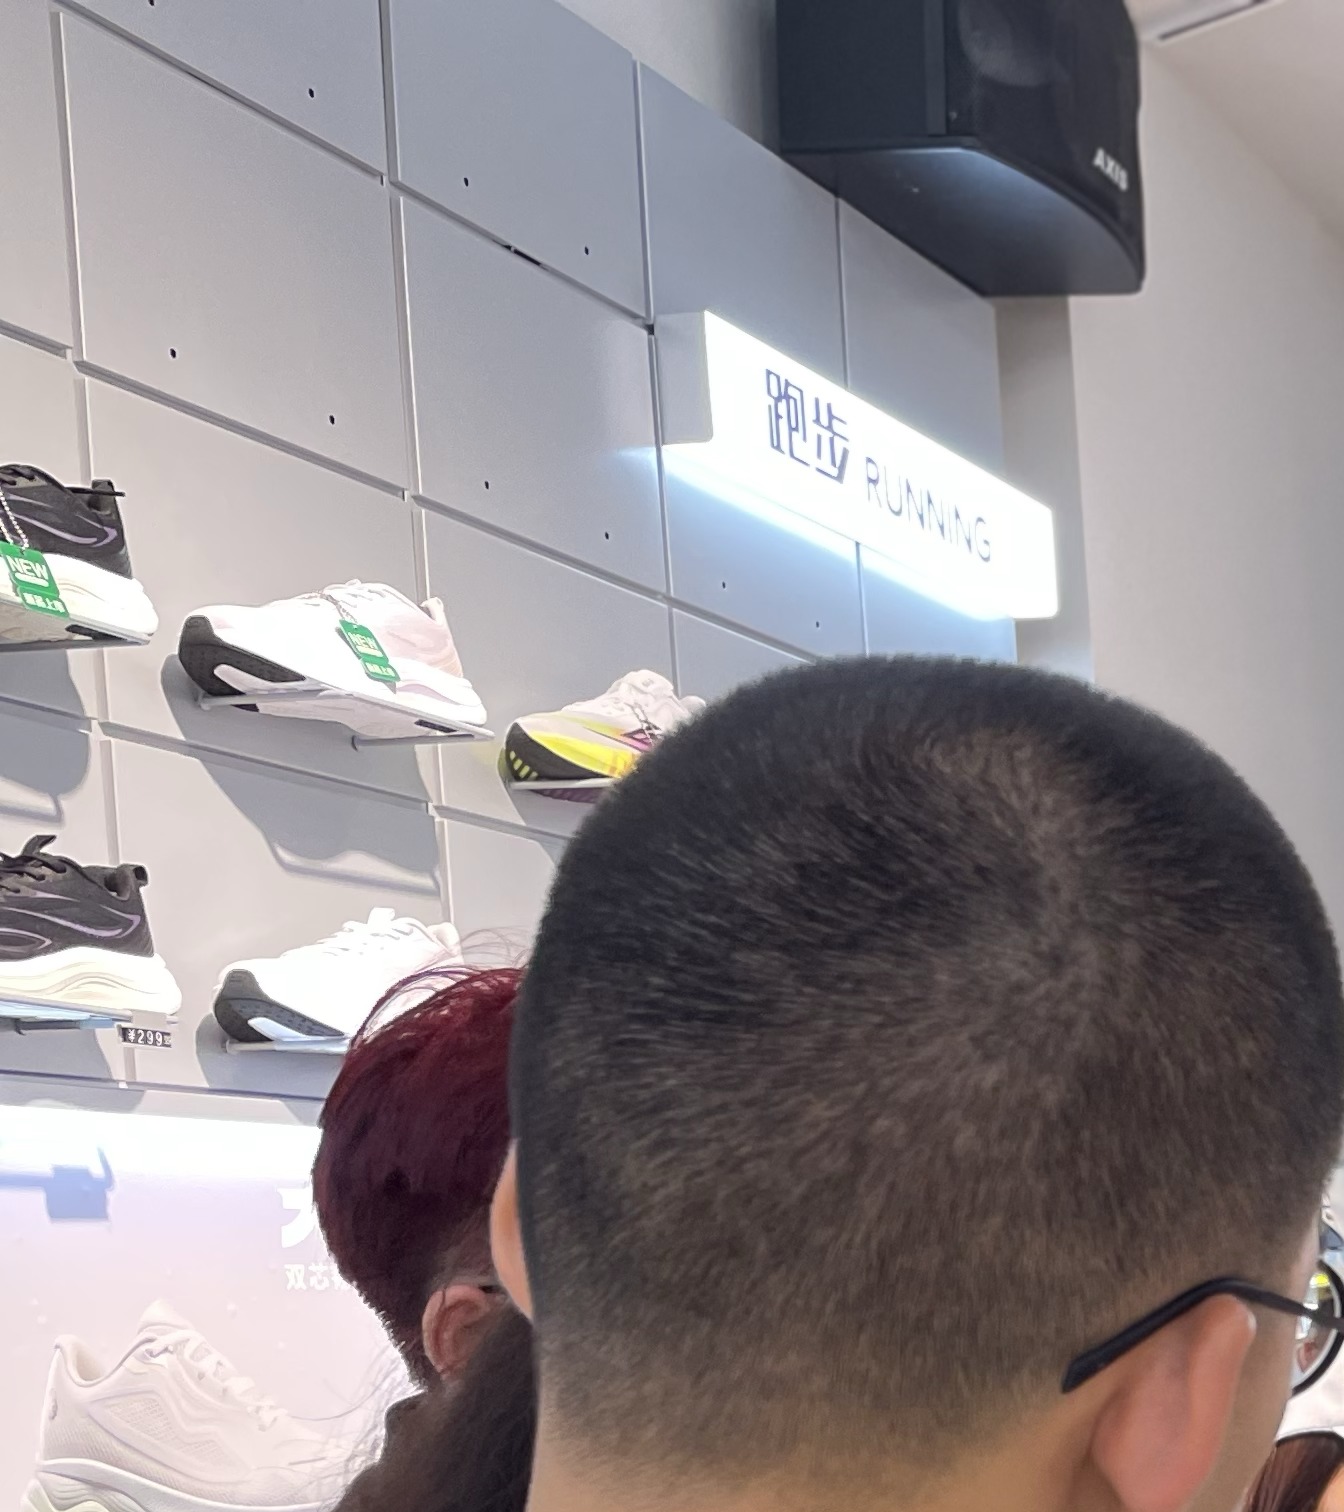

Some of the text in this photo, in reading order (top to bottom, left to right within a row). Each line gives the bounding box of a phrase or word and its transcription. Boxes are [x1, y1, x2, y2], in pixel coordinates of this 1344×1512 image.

[765, 368, 850, 484] 跑步
[865, 455, 991, 563] RUNNING
[6, 554, 49, 580] NEW
